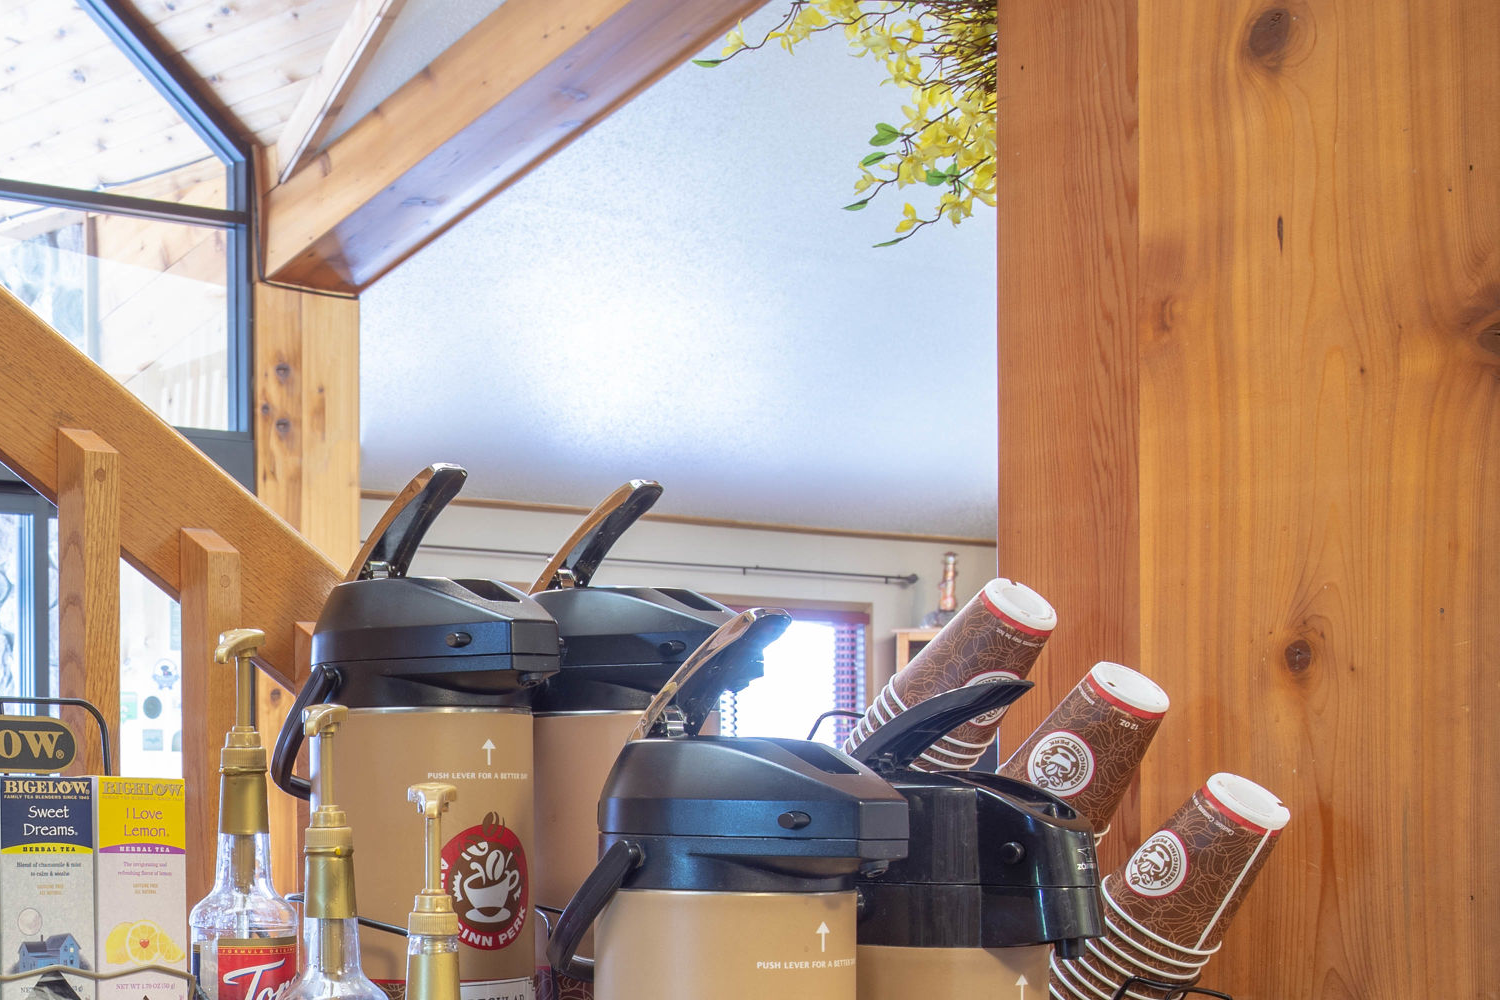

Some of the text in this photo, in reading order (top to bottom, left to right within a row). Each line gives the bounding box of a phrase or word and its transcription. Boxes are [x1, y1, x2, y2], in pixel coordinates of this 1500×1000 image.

[1070, 744, 1086, 786] AMERICINN
[428, 772, 449, 780] PUSH
[452, 772, 476, 780] LEVER
[478, 772, 492, 780] FOR
[4, 780, 87, 794] BIGELOW
[102, 782, 182, 796] BIGELOW
[28, 805, 69, 818] Sweet
[126, 808, 163, 820] I Love
[23, 823, 74, 836] Dreams
[124, 824, 166, 837] Lemon
[1160, 843, 1179, 886] AMERICINN
[500, 905, 526, 945] PERK
[784, 961, 810, 969] LEVER
[828, 960, 833, 968] A
